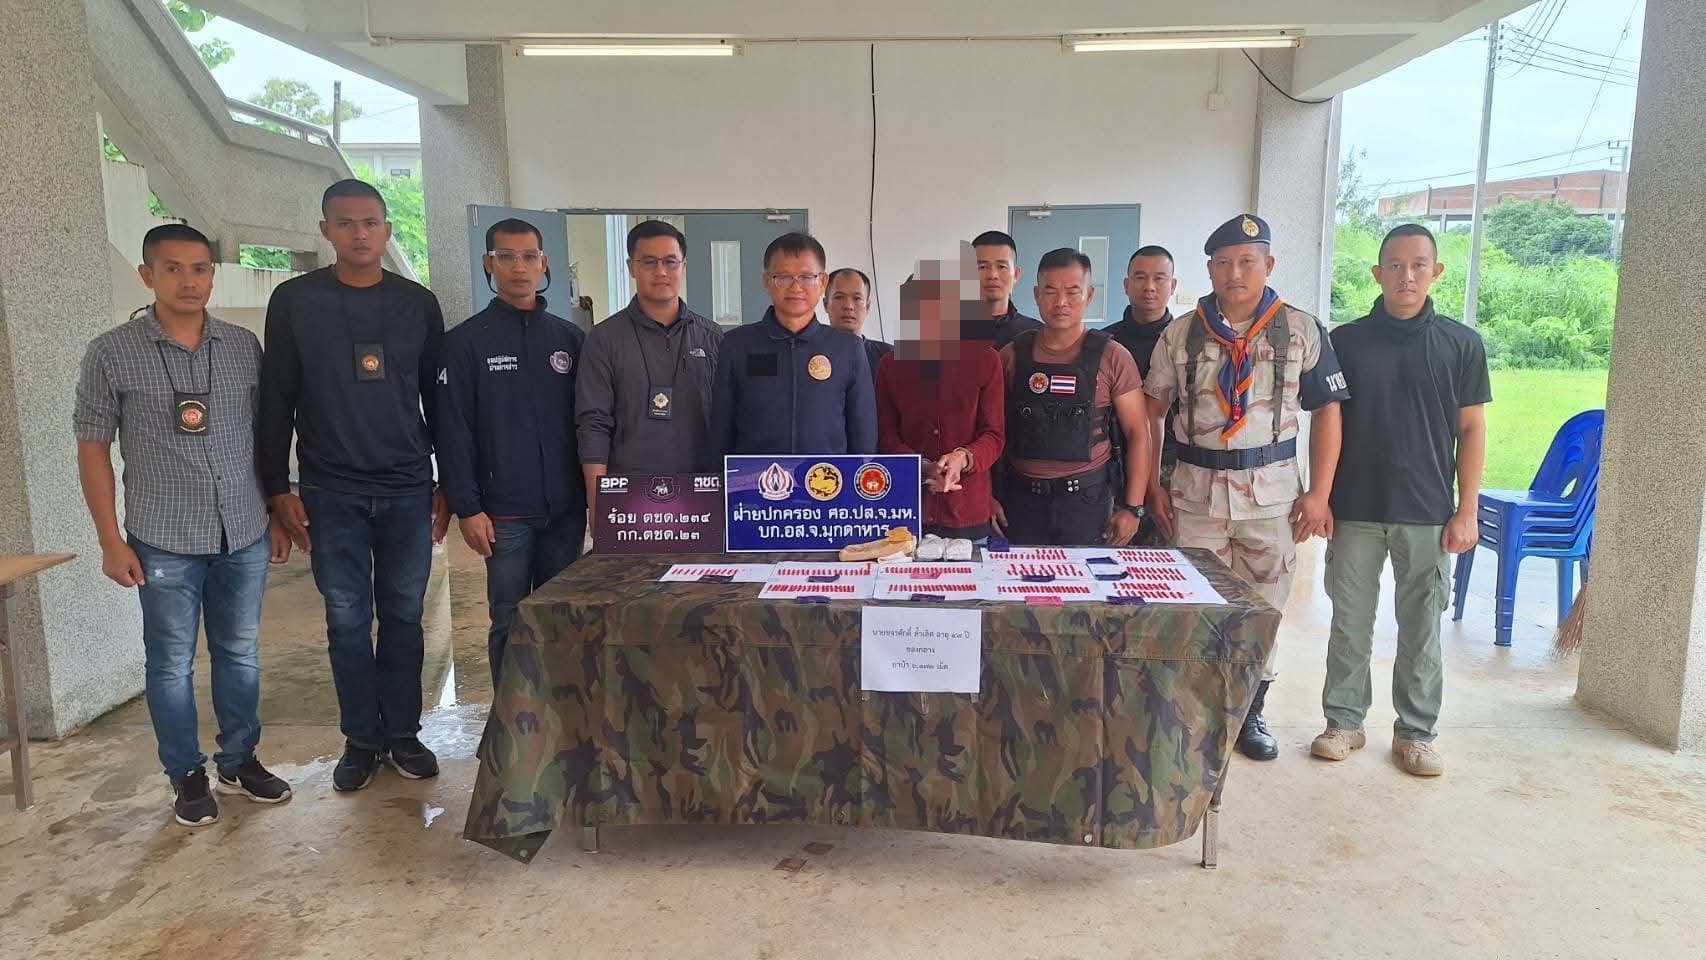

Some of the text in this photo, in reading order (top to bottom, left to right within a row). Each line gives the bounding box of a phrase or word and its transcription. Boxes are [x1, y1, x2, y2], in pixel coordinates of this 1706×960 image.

[608, 507, 711, 524] ร้อย ตชด.๒๓๔
[733, 502, 917, 521] ฝ่ายปกครอง ศอ.ปส.จ.มห.
[617, 529, 700, 541] กก.ตชด.๒๓
[758, 524, 890, 544] บก.อส.จ.มุกดาหาร
